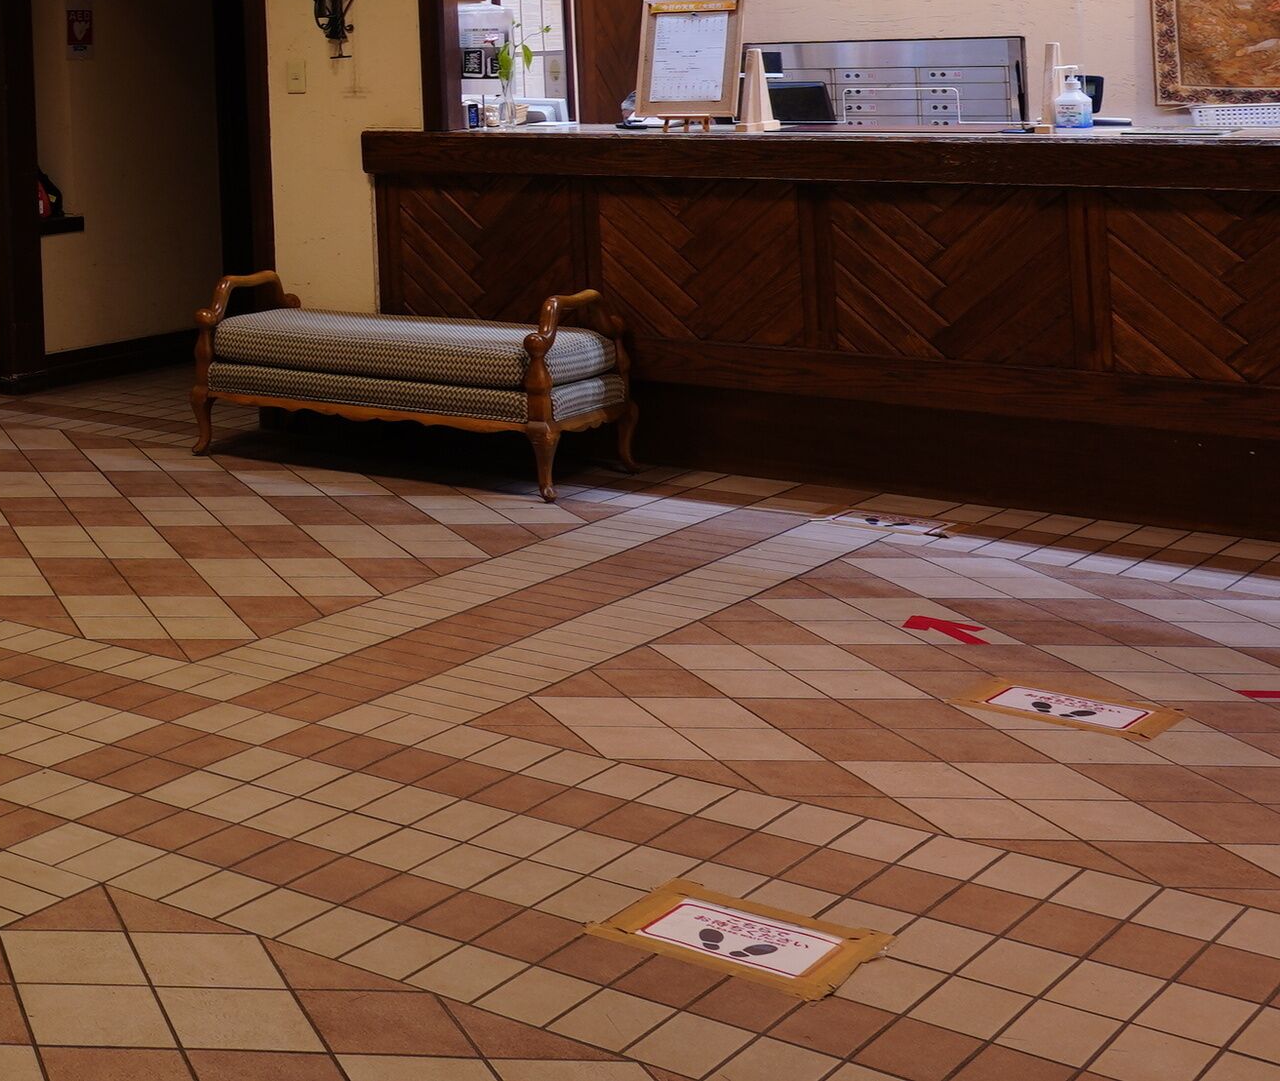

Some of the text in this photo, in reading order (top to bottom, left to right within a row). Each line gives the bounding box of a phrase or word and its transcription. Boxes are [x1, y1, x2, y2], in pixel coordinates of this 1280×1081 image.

[68, 11, 91, 21] AED
[694, 915, 809, 949] お待ちください
[726, 918, 790, 936] こちらで
